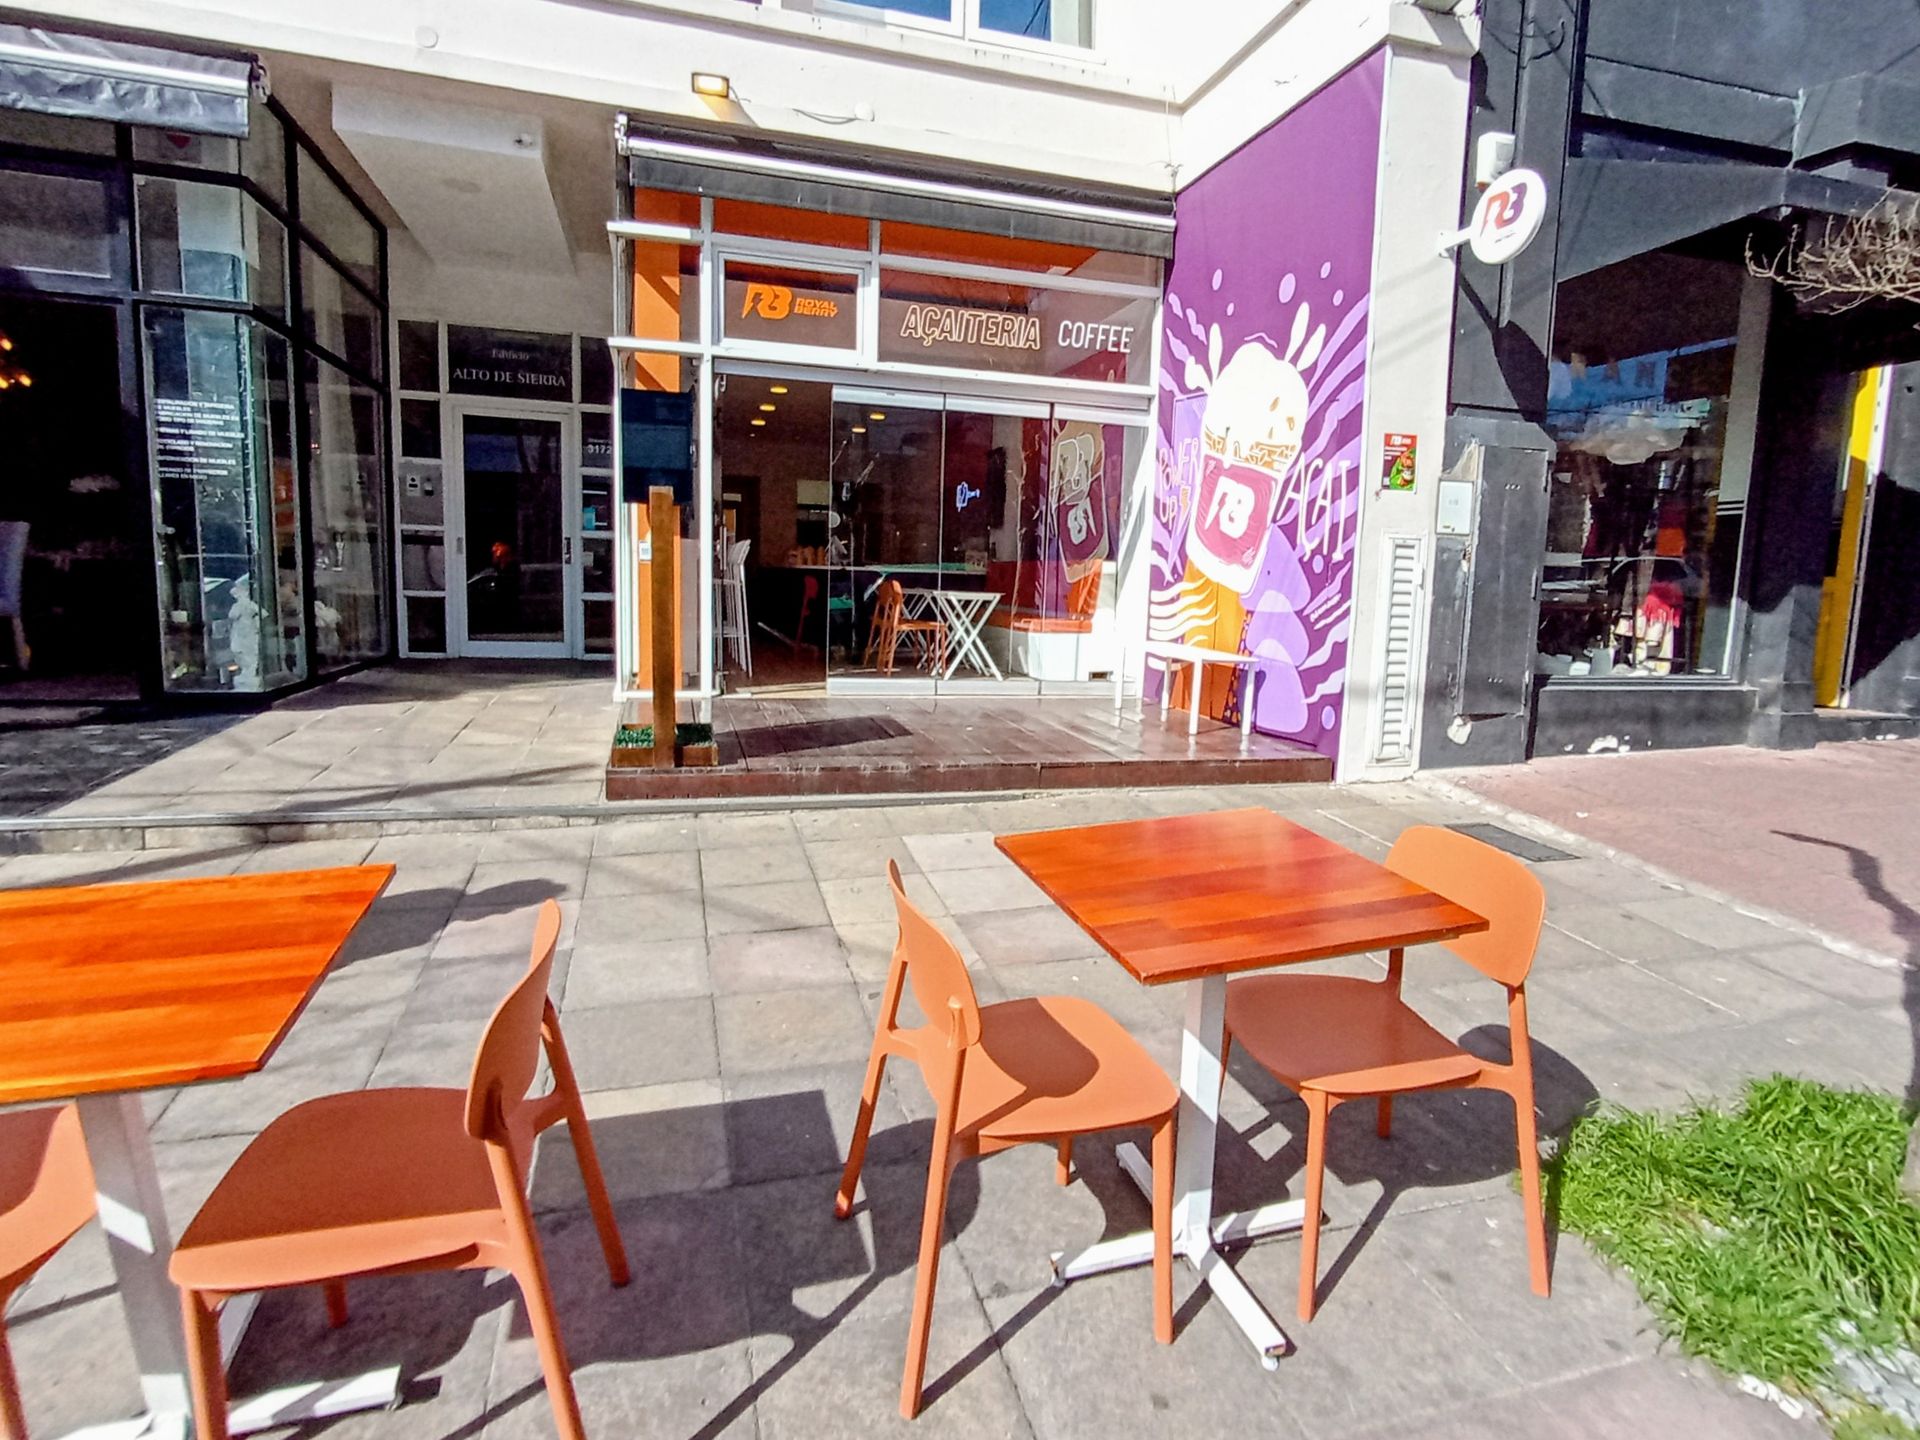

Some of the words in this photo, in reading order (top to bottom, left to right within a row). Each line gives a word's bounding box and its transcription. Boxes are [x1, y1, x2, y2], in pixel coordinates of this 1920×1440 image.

[794, 297, 838, 311] ROYAL
[794, 306, 839, 319] BERRY
[900, 304, 1040, 350] AÇAITERIA
[1058, 320, 1134, 354] COFFEE
[453, 367, 490, 381] ALTO
[494, 371, 514, 383] DE
[517, 371, 567, 388] SIERRA
[1159, 437, 1199, 489] POWER
[1159, 491, 1179, 530] UP
[1276, 452, 1352, 562] AÇAI
